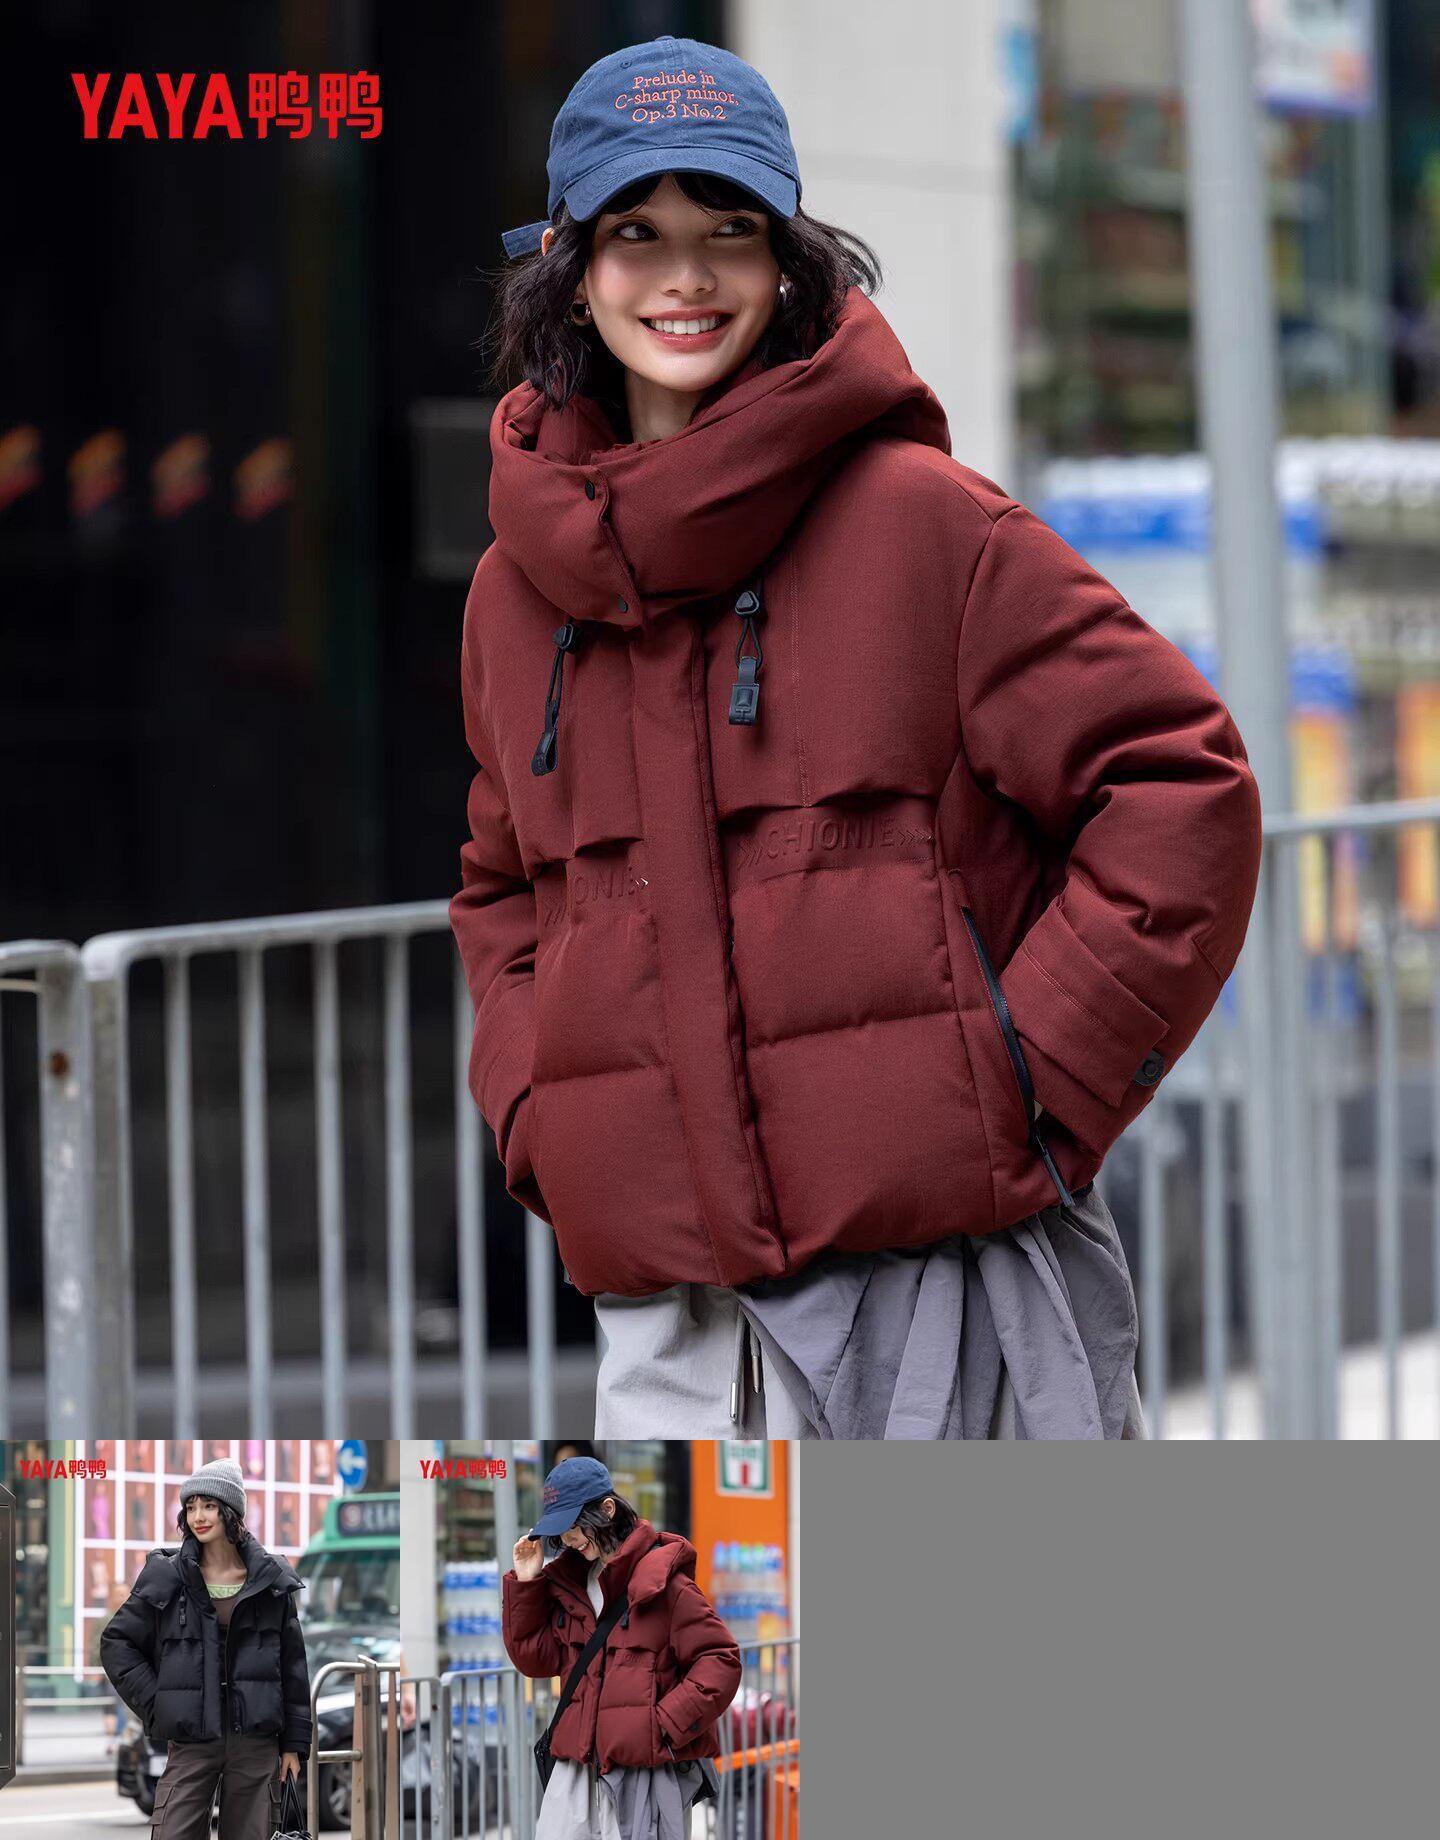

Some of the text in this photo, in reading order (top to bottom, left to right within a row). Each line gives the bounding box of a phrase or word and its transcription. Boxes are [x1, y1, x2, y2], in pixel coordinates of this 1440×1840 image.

[632, 70, 716, 89] Prelude in
[614, 89, 682, 109] C-sharp
[632, 103, 727, 124] Op.3 No.2
